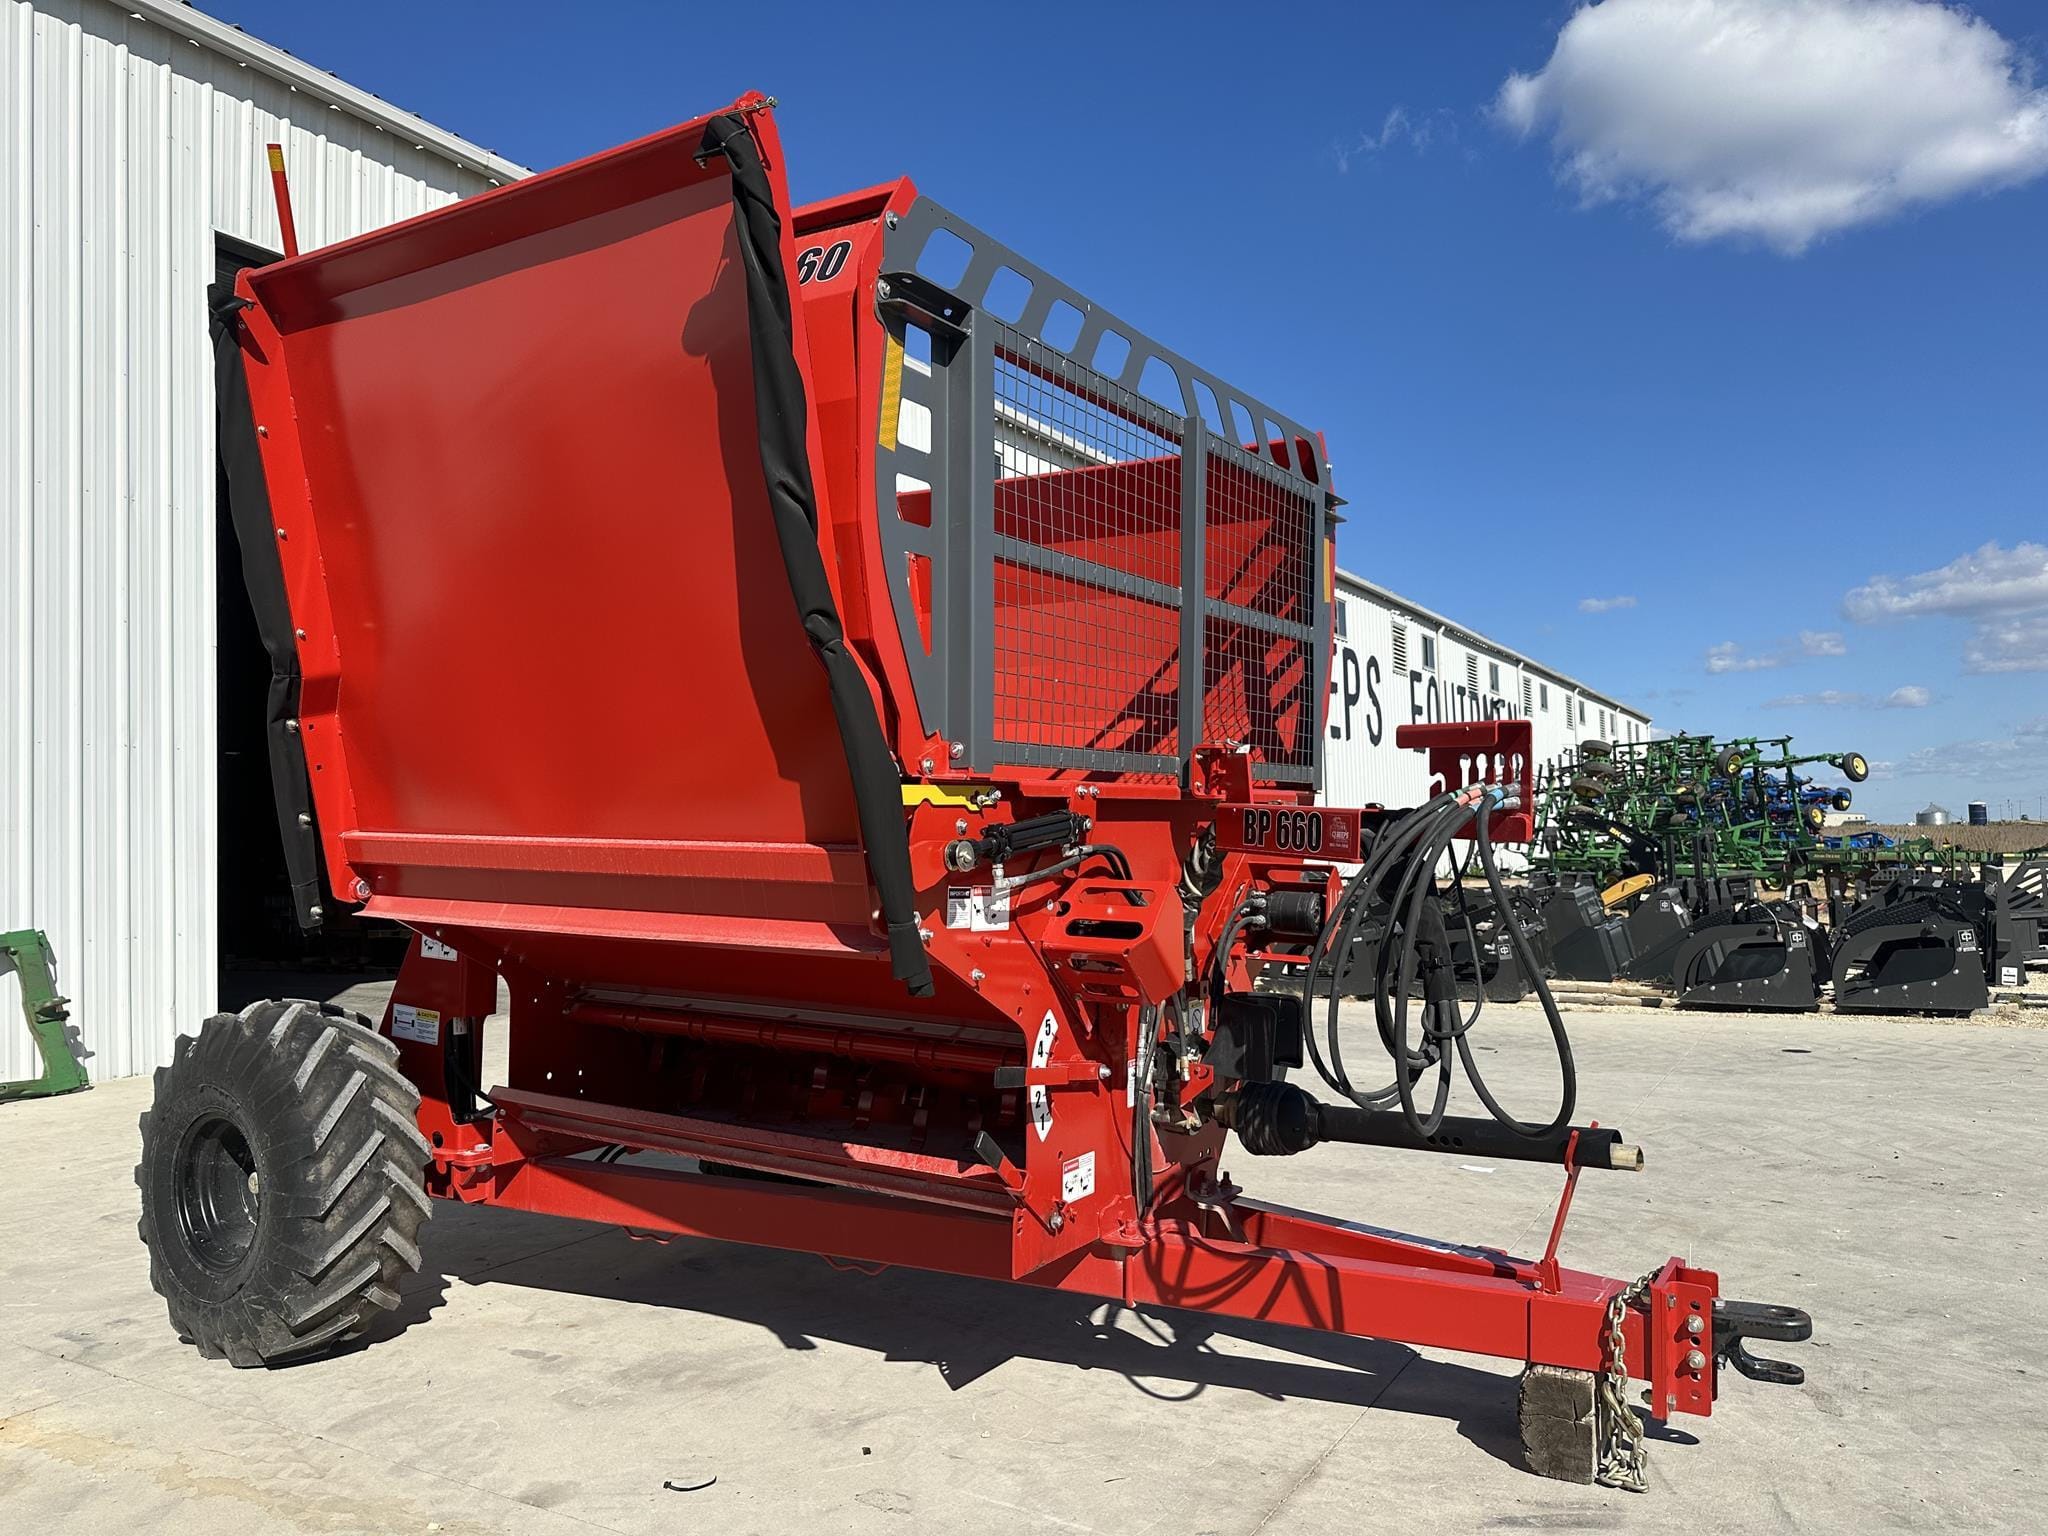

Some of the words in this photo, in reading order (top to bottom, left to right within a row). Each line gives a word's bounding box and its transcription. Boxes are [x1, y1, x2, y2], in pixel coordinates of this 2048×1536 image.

[1243, 808, 1272, 847] BP
[1276, 810, 1322, 853] 660
[1045, 1019, 1051, 1036] 5
[1038, 1040, 1043, 1057] 4
[1035, 1090, 1041, 1109] 2
[1040, 1113, 1045, 1131] 1
